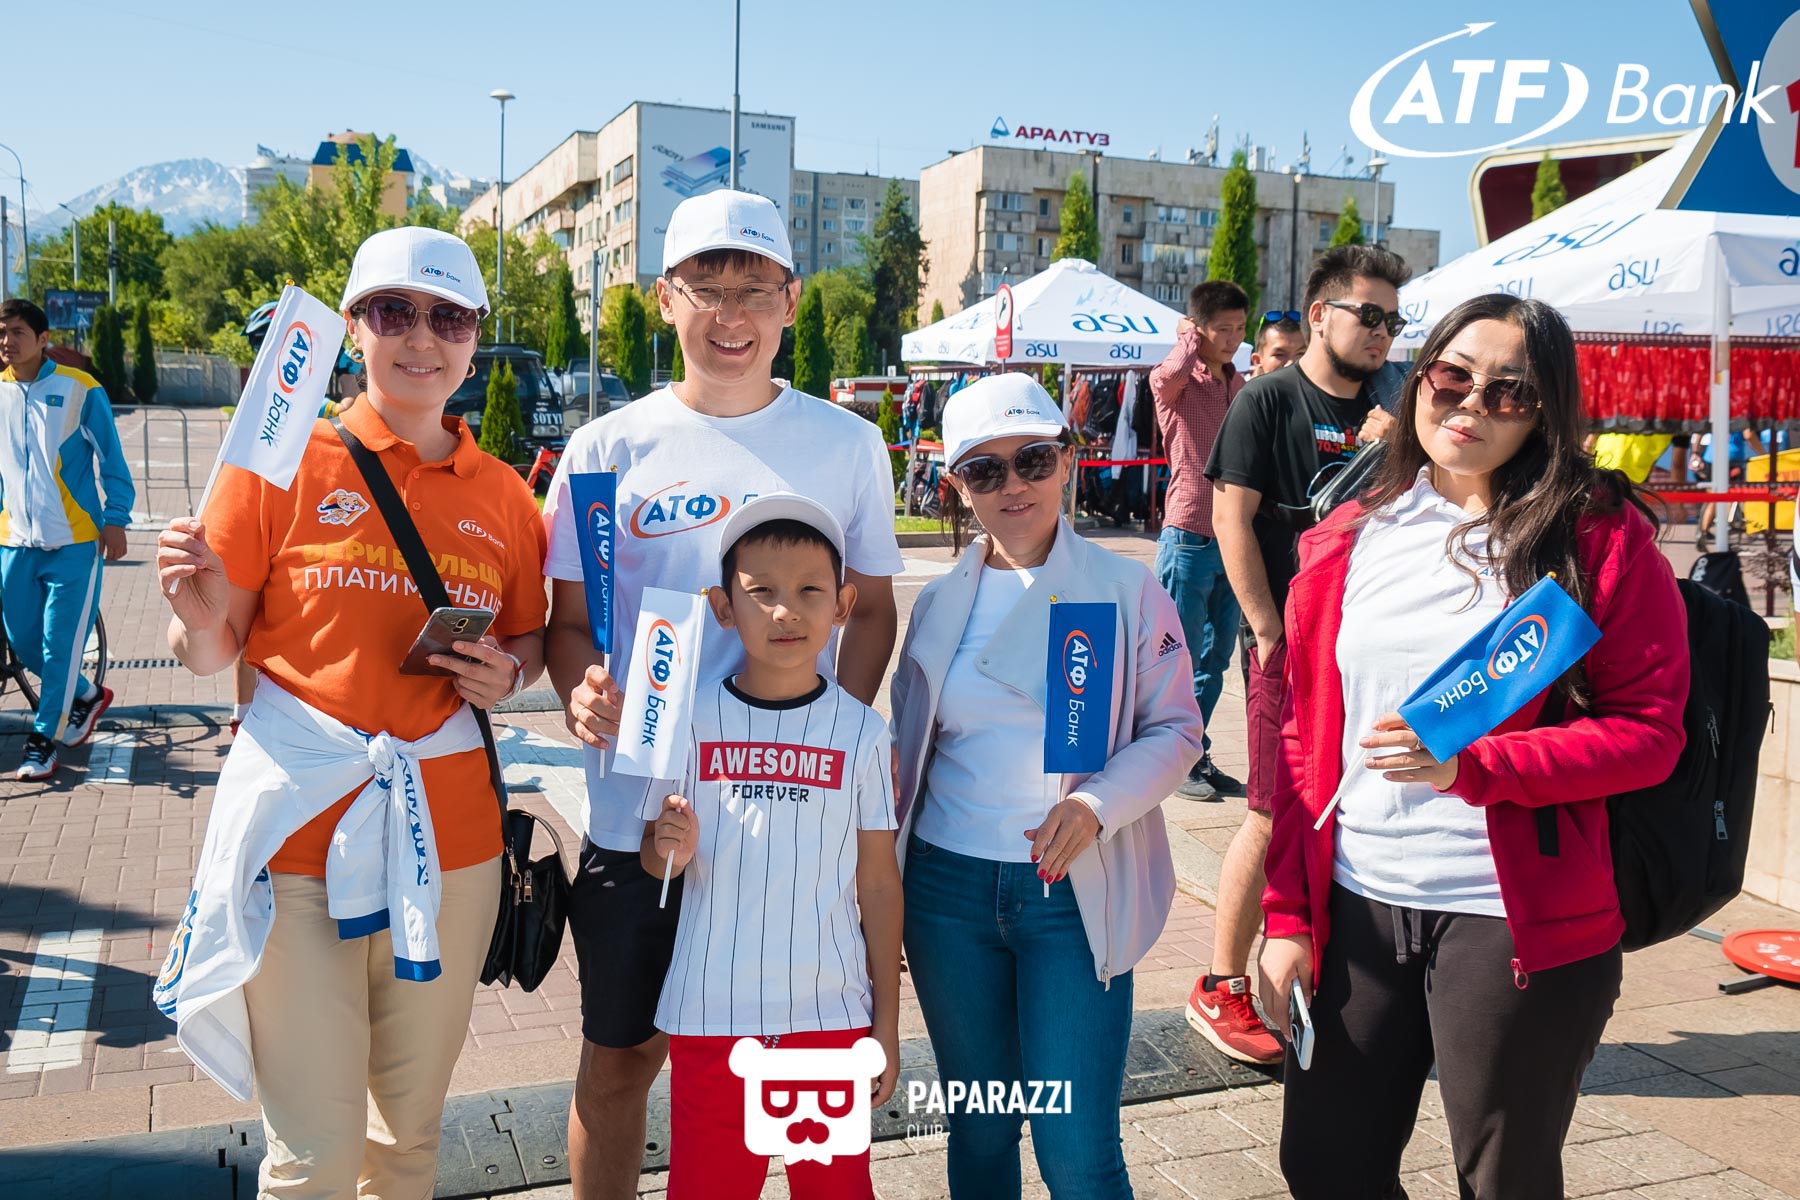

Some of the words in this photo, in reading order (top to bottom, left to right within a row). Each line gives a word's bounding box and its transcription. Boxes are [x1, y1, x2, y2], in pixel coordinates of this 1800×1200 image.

[751, 121, 786, 131] SAMSUNG
[1492, 212, 1647, 267] asu
[1608, 257, 1660, 291] asu
[1071, 311, 1160, 335] asu
[283, 331, 310, 386] АТФ
[1025, 342, 1059, 358] asu
[1109, 343, 1142, 360] asu
[260, 392, 290, 447] Банк
[642, 494, 717, 527] АТФ
[488, 533, 505, 550] Bank
[304, 566, 398, 595] ПЛАТИ
[652, 629, 674, 684] АТФ
[1069, 638, 1089, 687] АТФ
[1158, 641, 1183, 657] adidas
[1495, 623, 1540, 675] АТФ
[1433, 670, 1489, 713] Банк
[641, 694, 666, 748] Банк
[1067, 698, 1085, 747] Банк
[709, 747, 834, 783] AWESOME
[731, 784, 809, 803] FOREVER
